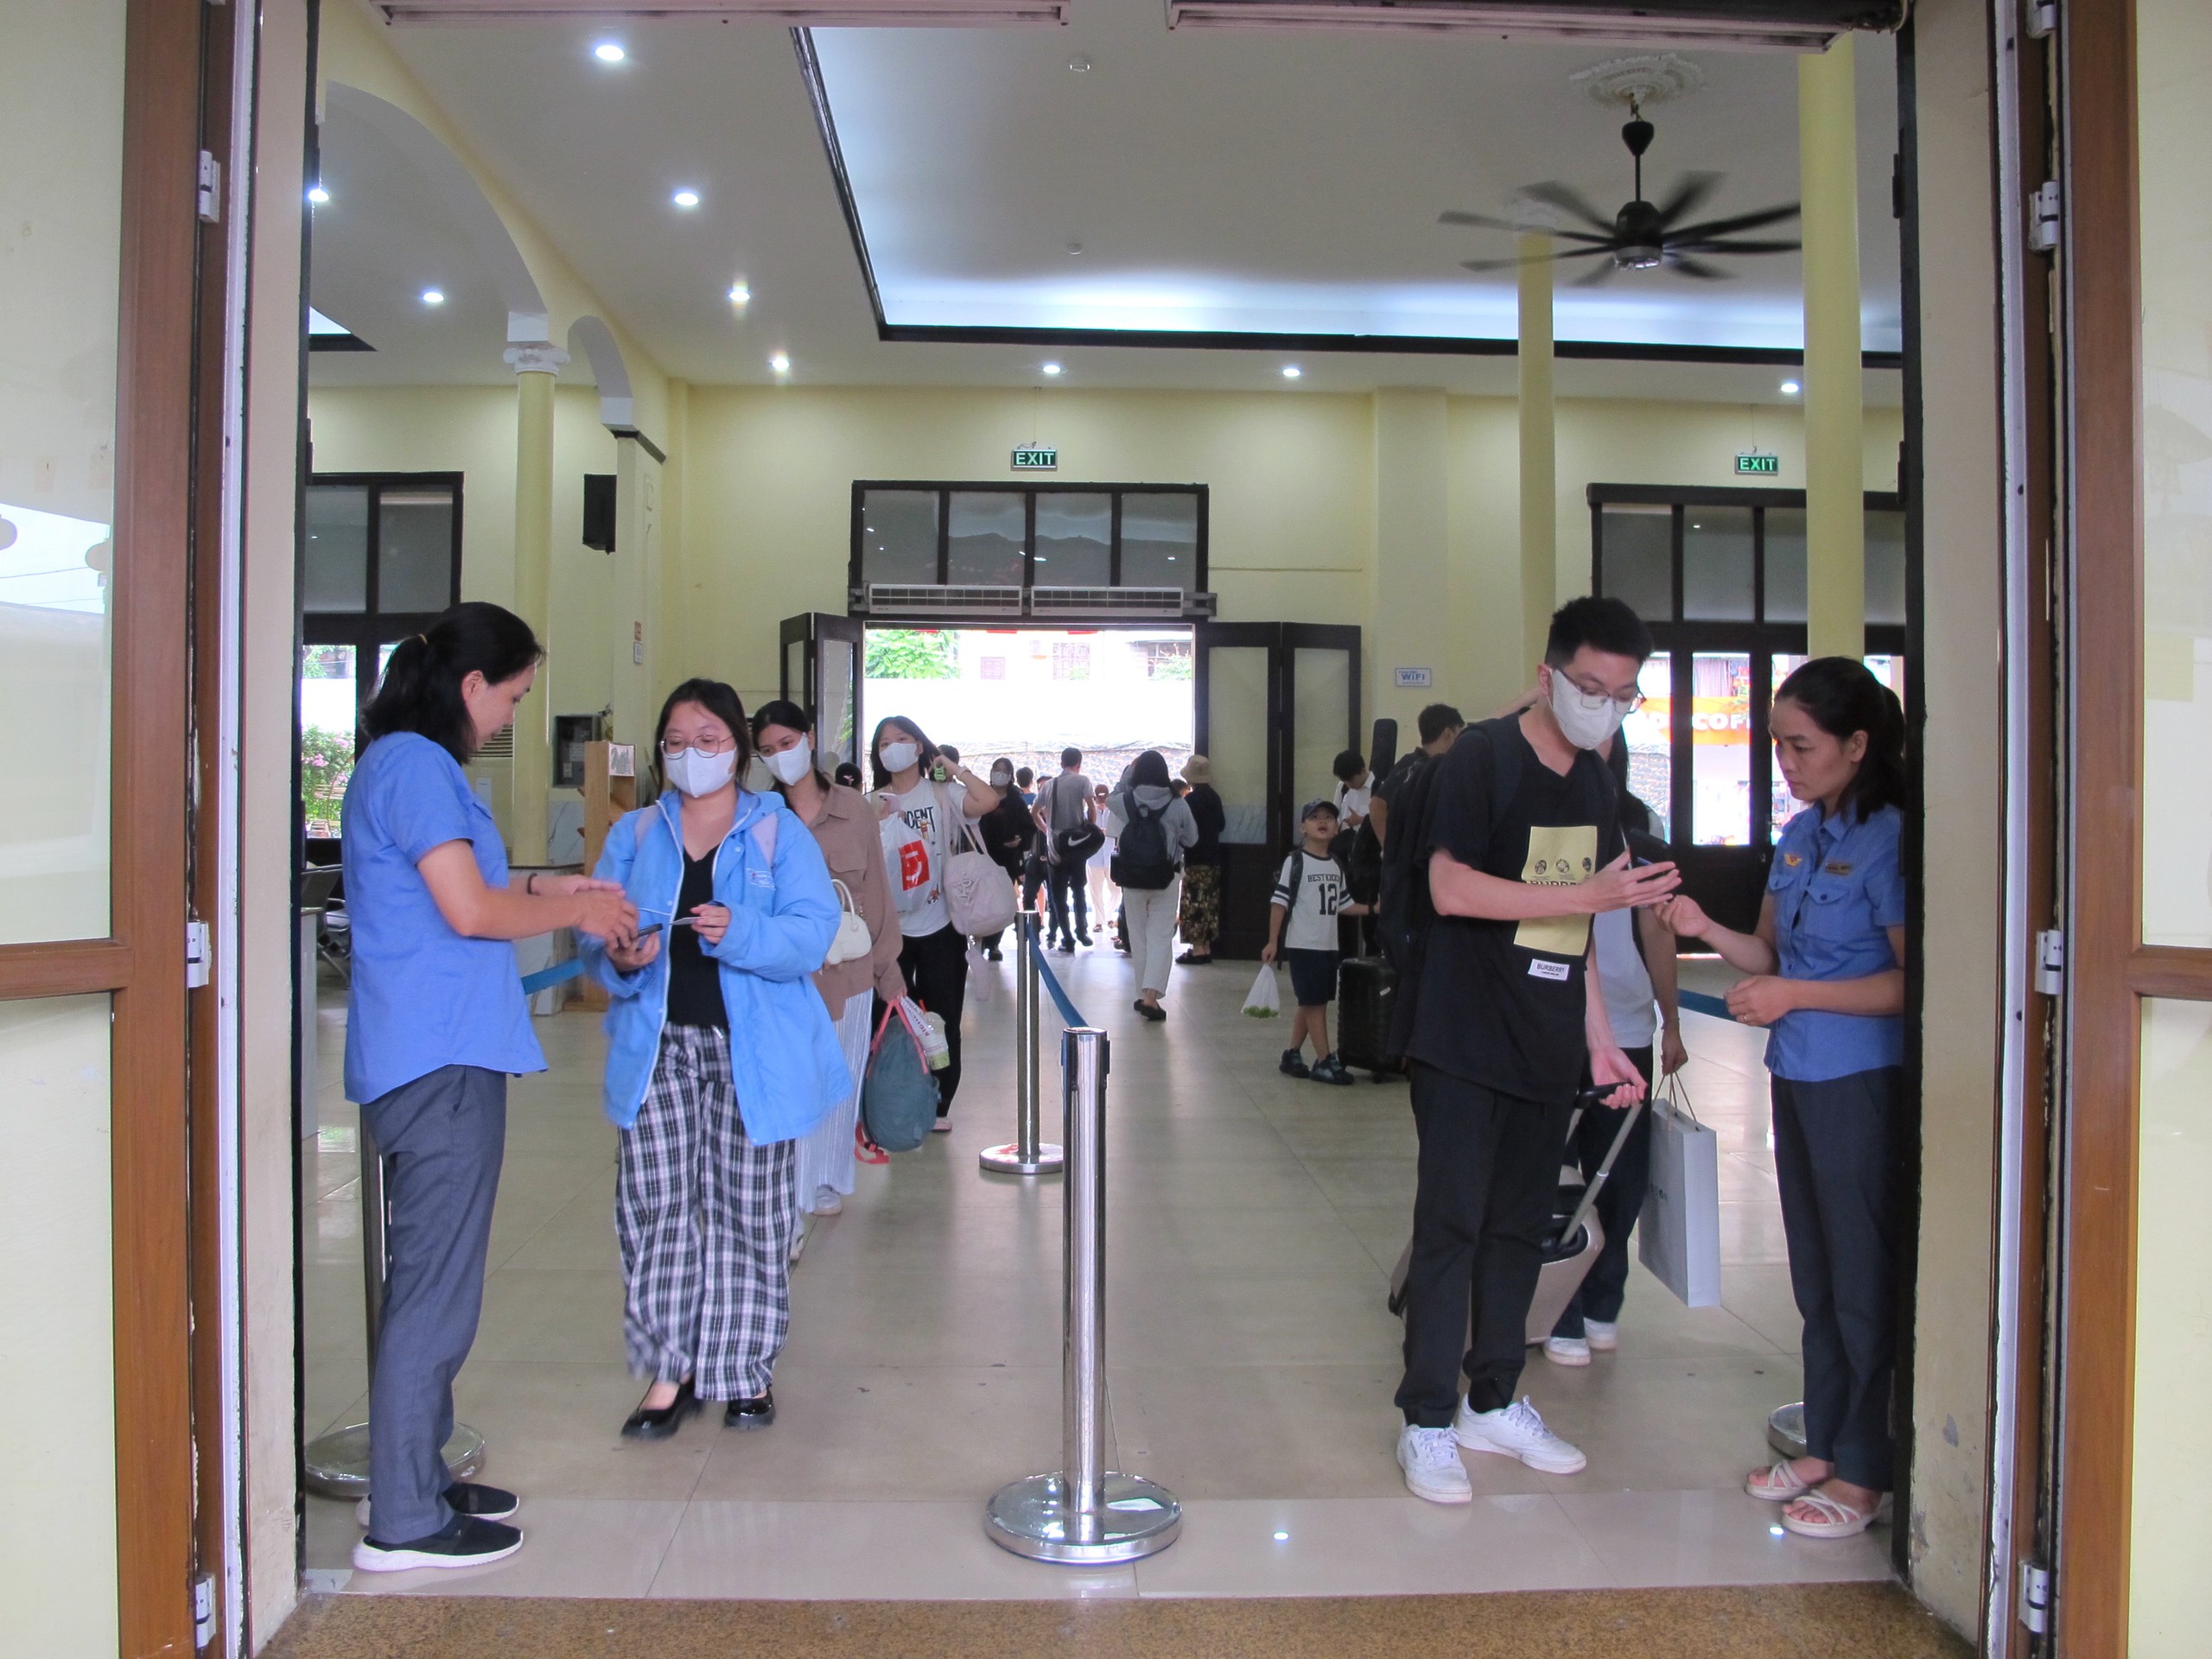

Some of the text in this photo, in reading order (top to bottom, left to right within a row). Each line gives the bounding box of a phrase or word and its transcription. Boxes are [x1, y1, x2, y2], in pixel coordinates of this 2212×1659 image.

[1015, 452, 1054, 465] EXIT
[1739, 457, 1776, 471] EXIT
[1307, 874, 1325, 882] BEST
[1319, 883, 1338, 915] 12
[1536, 963, 1565, 973] BURBERRY
